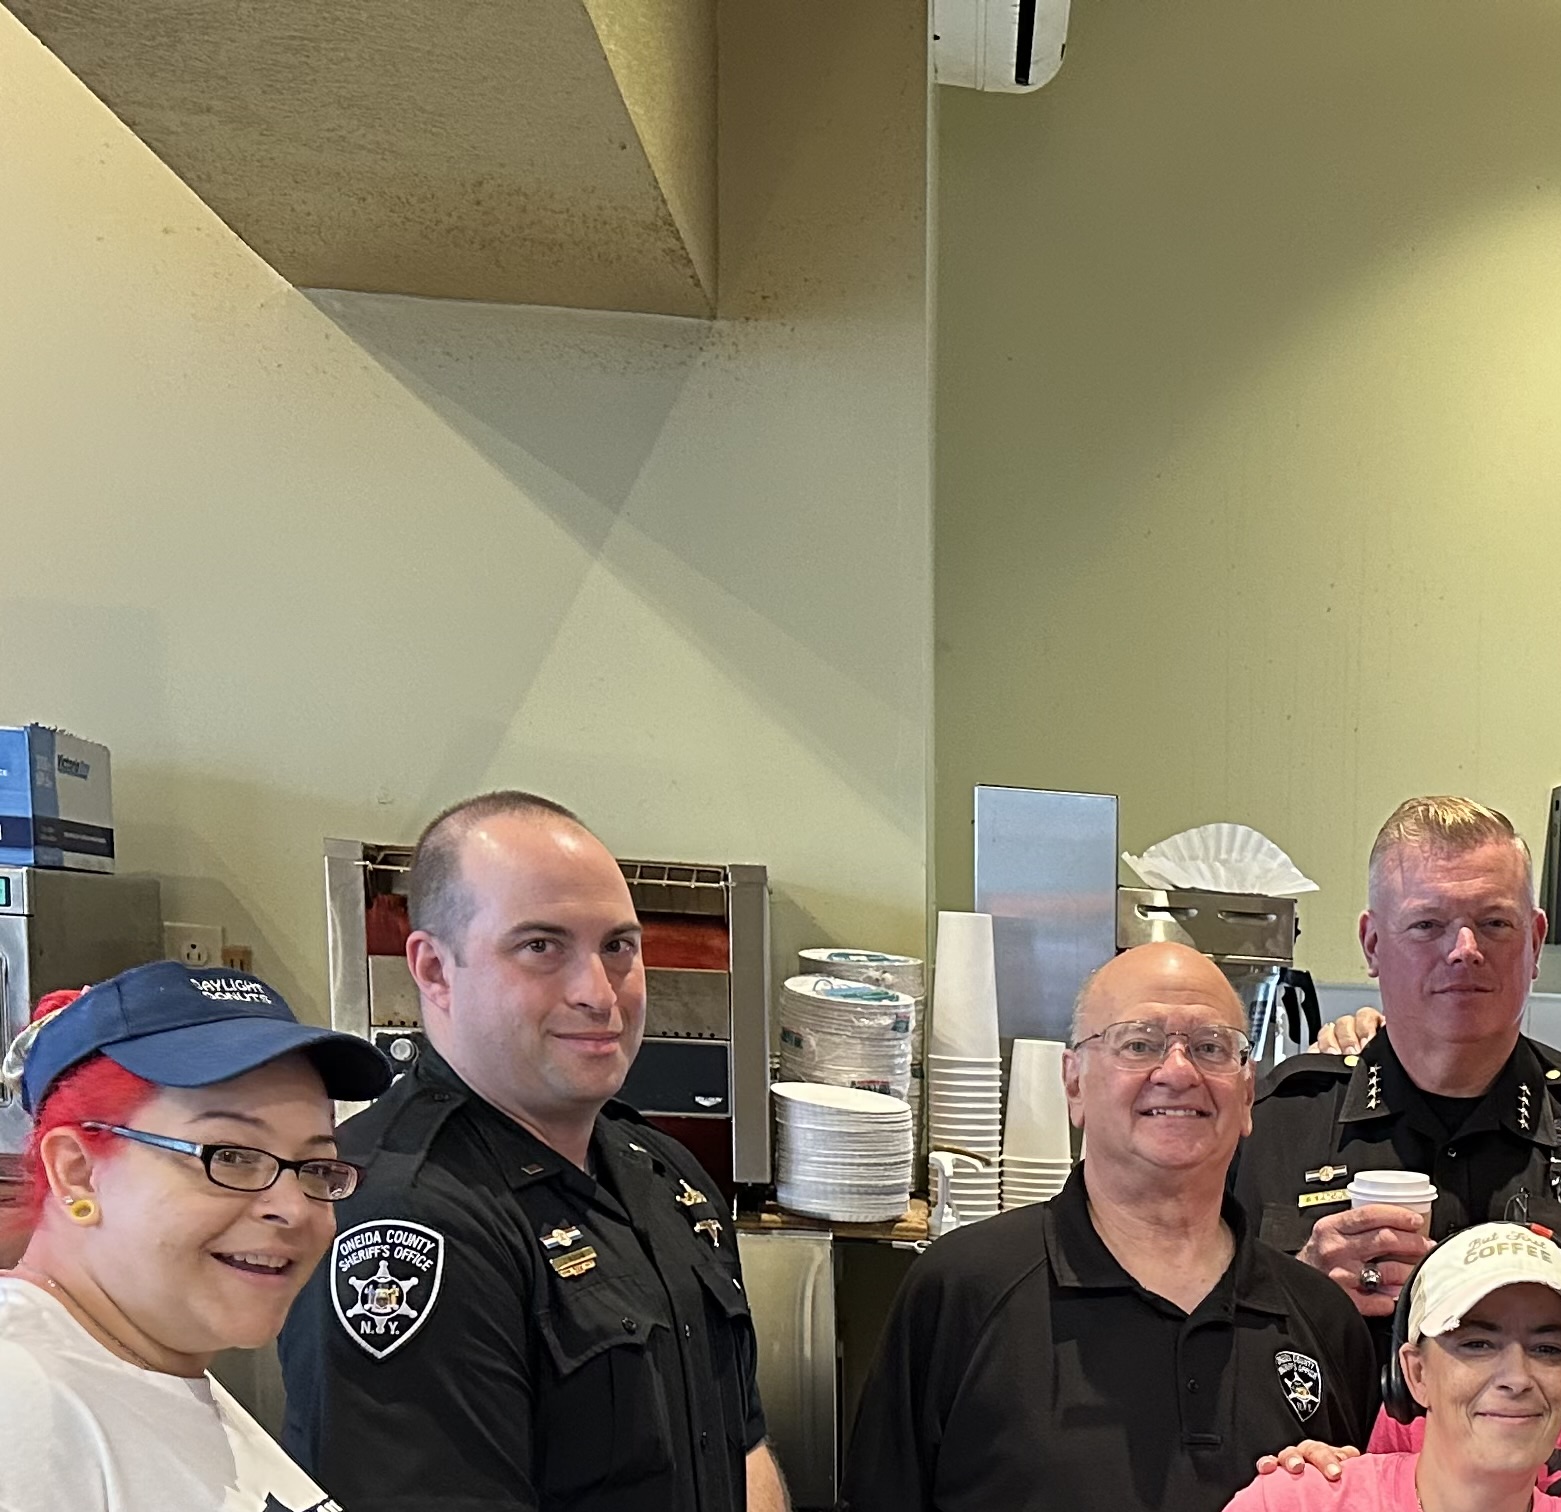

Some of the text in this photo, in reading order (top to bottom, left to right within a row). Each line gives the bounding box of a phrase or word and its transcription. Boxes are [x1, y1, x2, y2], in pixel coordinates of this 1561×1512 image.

[340, 1229, 435, 1256] ONEIDA COUNTY
[1468, 1232, 1499, 1249] But
[339, 1244, 433, 1272] SHERIFF'S OFFICE
[1463, 1242, 1553, 1265] COFFEE
